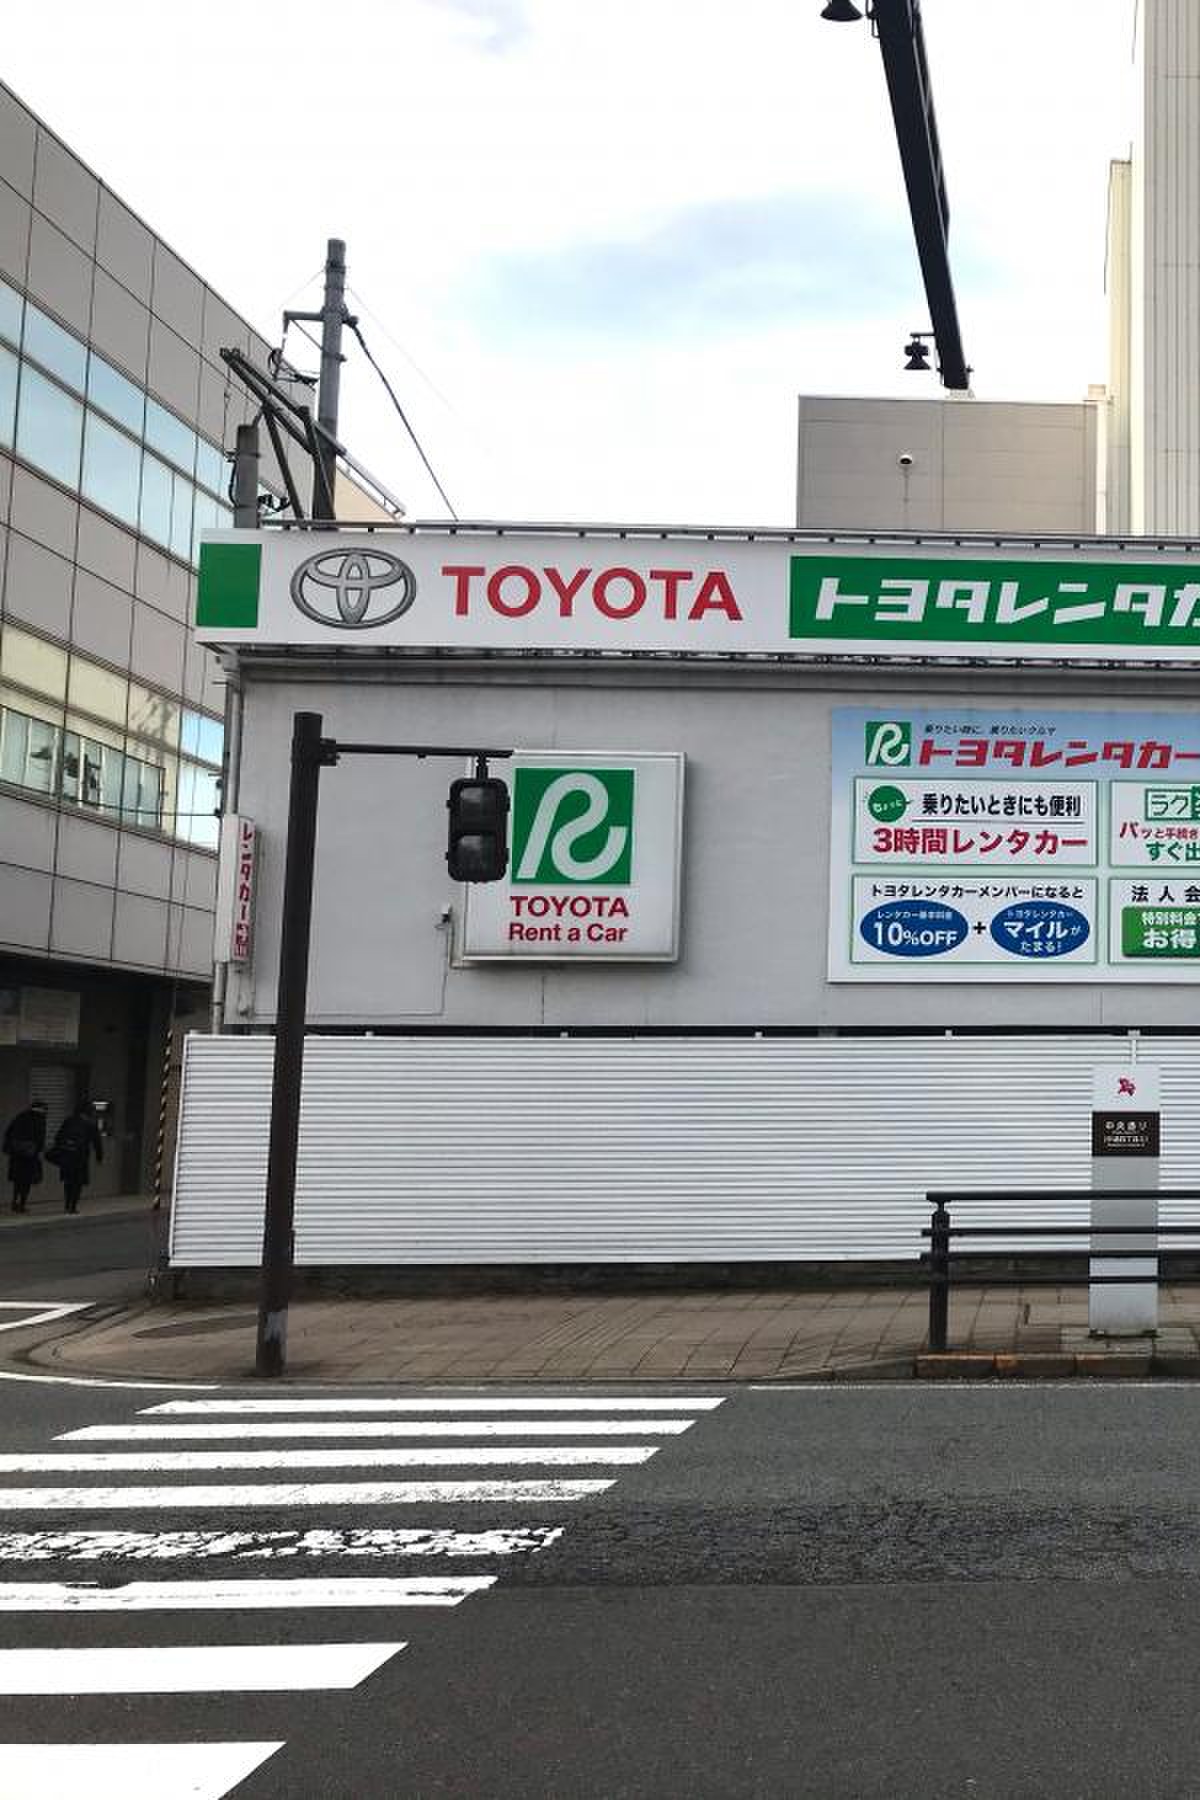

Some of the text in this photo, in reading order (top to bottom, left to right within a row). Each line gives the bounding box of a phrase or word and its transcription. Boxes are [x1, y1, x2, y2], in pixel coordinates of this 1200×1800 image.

[441, 565, 743, 622] TOYOTA
[922, 793, 1082, 817] 乗りたいときにも便利
[873, 828, 1088, 855] 3時間レンタカー
[872, 884, 1084, 899] トヨタレンタカーメンバーになると
[510, 896, 629, 917] TOYOTA
[509, 922, 627, 941] Rent a Car
[872, 922, 958, 946] 10%OFF
